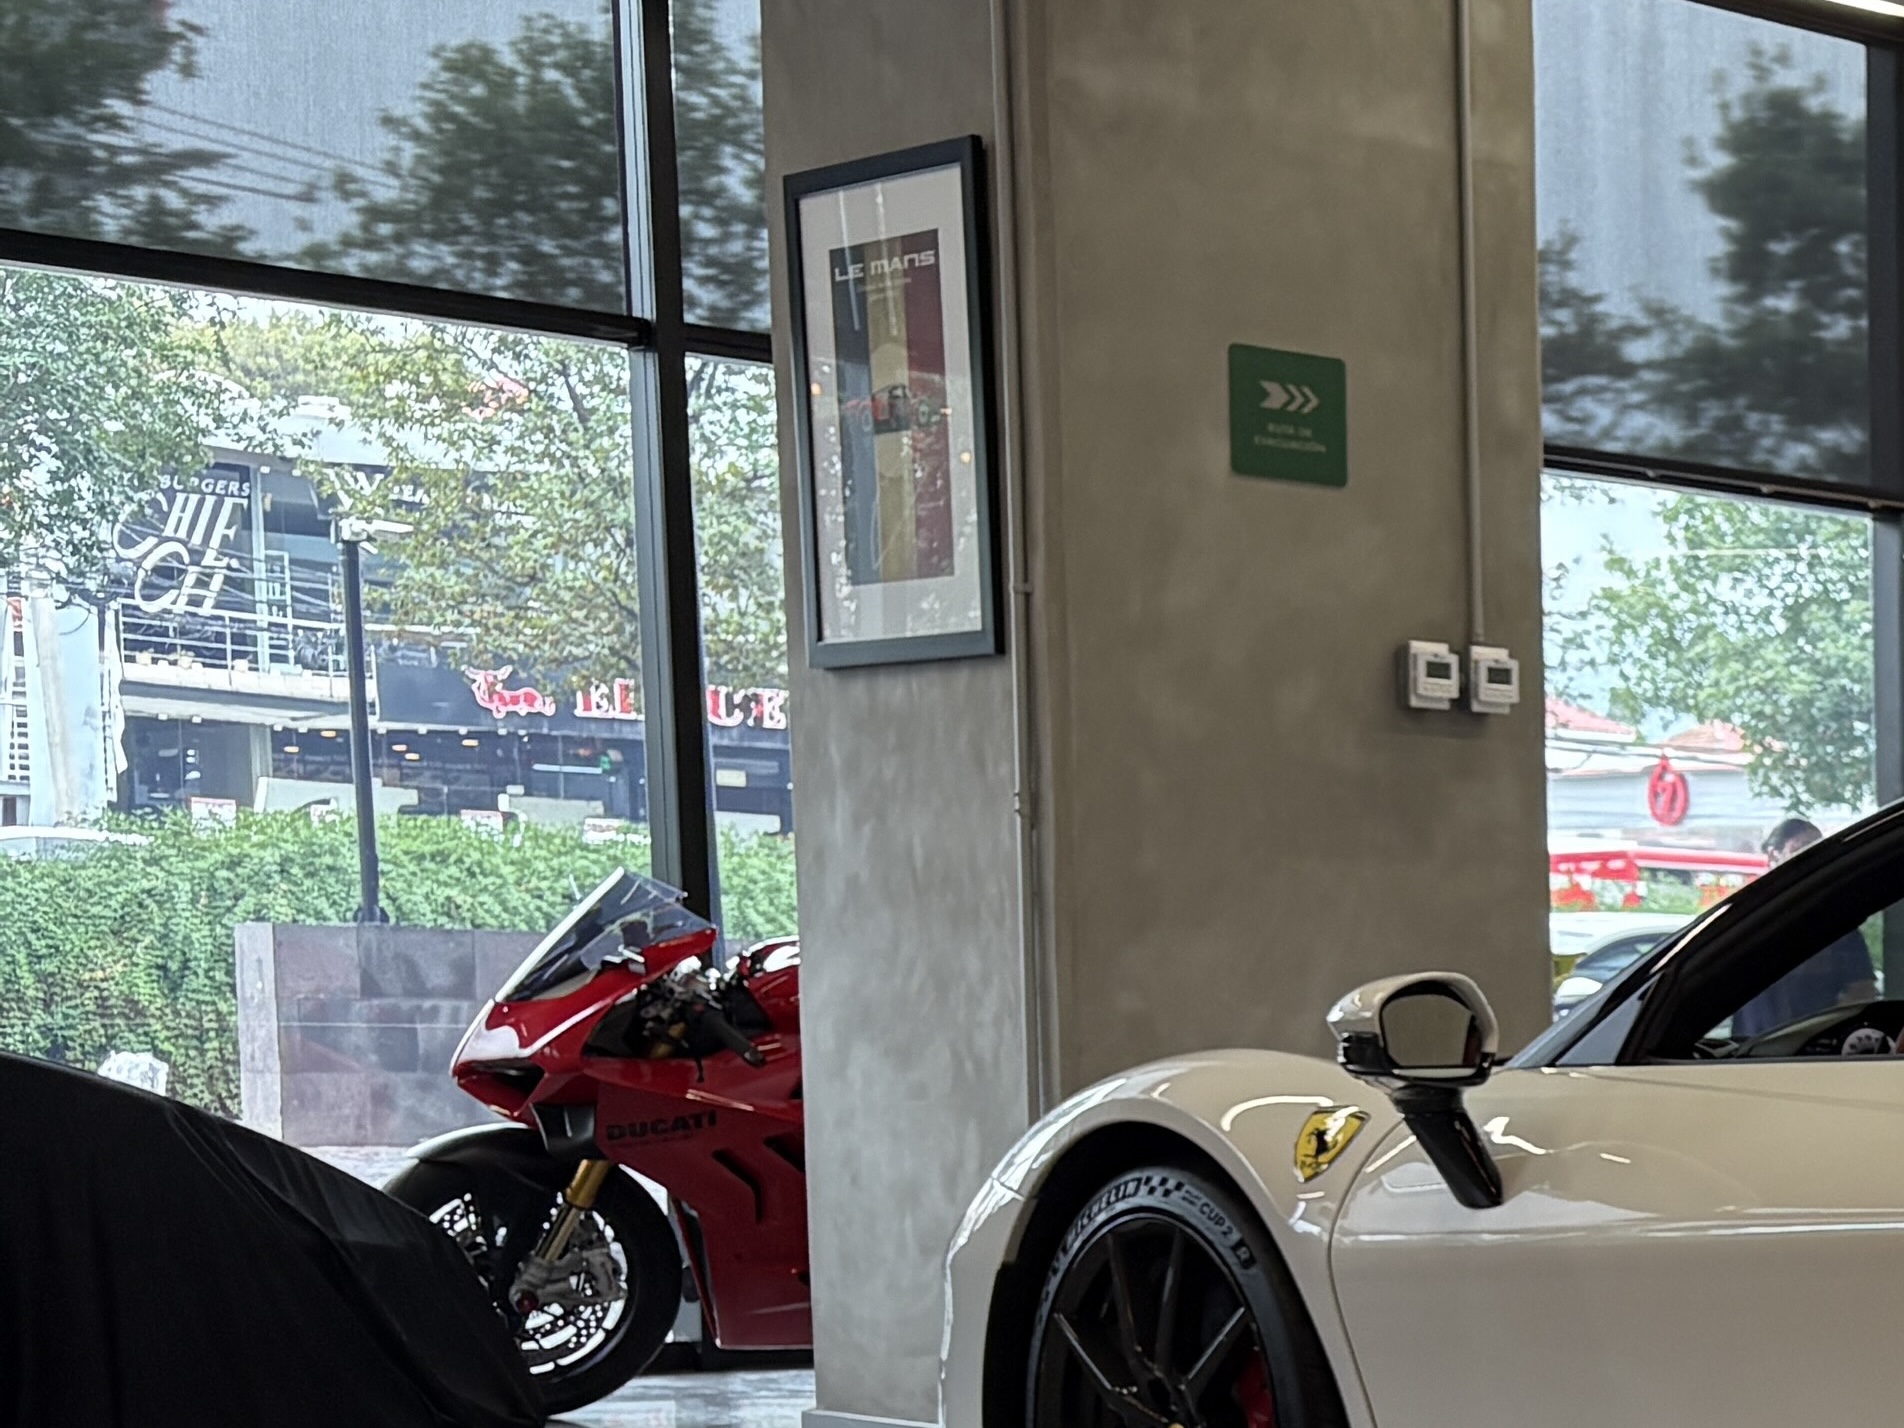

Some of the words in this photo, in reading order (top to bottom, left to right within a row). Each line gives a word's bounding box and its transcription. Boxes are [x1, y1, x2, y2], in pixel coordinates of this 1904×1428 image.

[834, 262, 865, 282] LE
[870, 250, 936, 276] MANS
[606, 1109, 718, 1141] DUCATI
[1200, 1201, 1226, 1229] CUP
